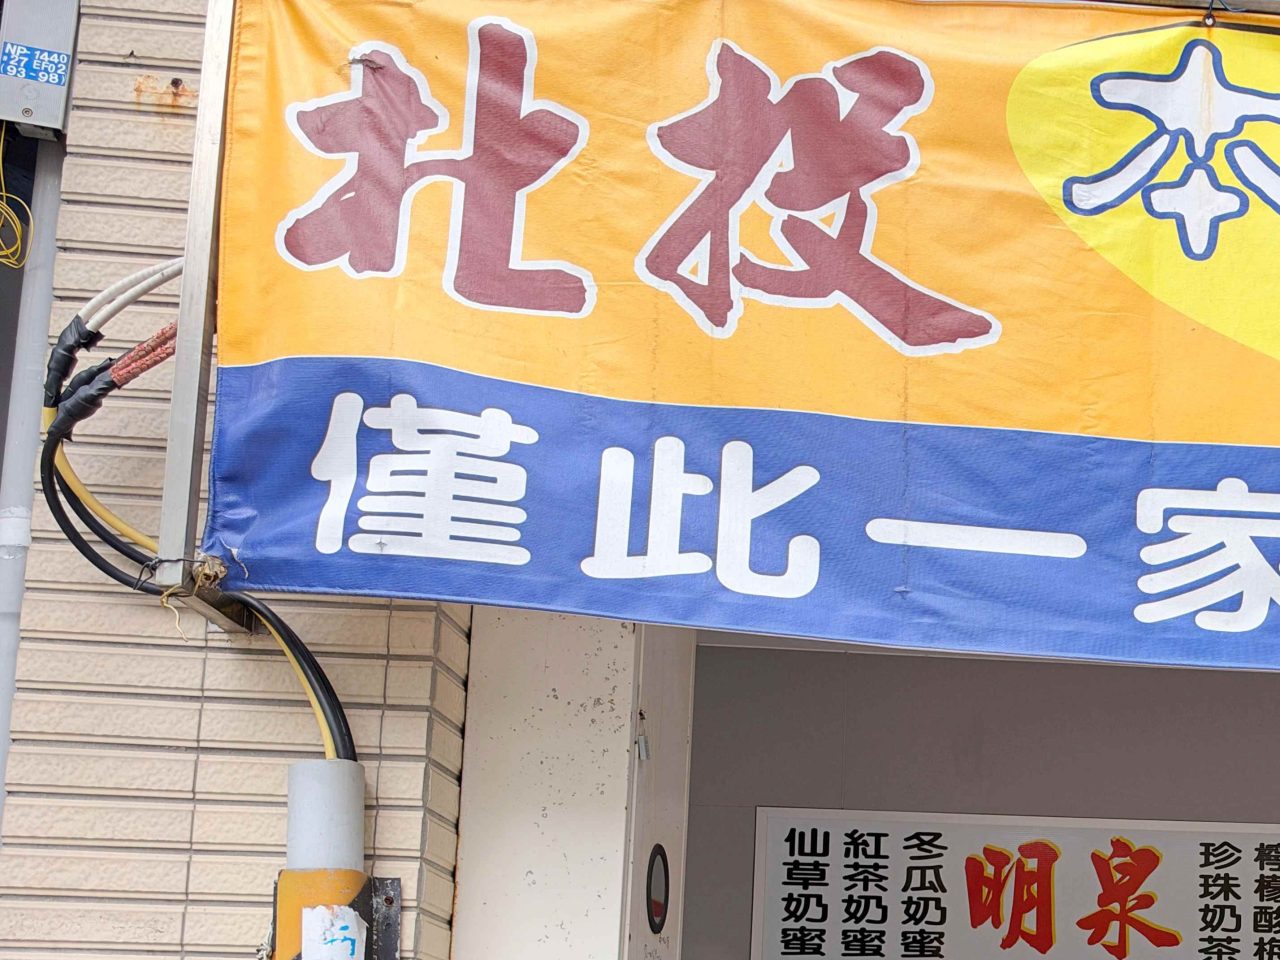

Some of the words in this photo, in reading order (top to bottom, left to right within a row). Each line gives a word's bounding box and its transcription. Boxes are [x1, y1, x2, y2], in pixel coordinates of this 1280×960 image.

[274, 15, 1002, 356] 北投
[780, 828, 830, 956] 仙草奶蜜
[841, 829, 890, 957] 紅茶奶蜜
[901, 831, 948, 958] 冬瓜奶蜜
